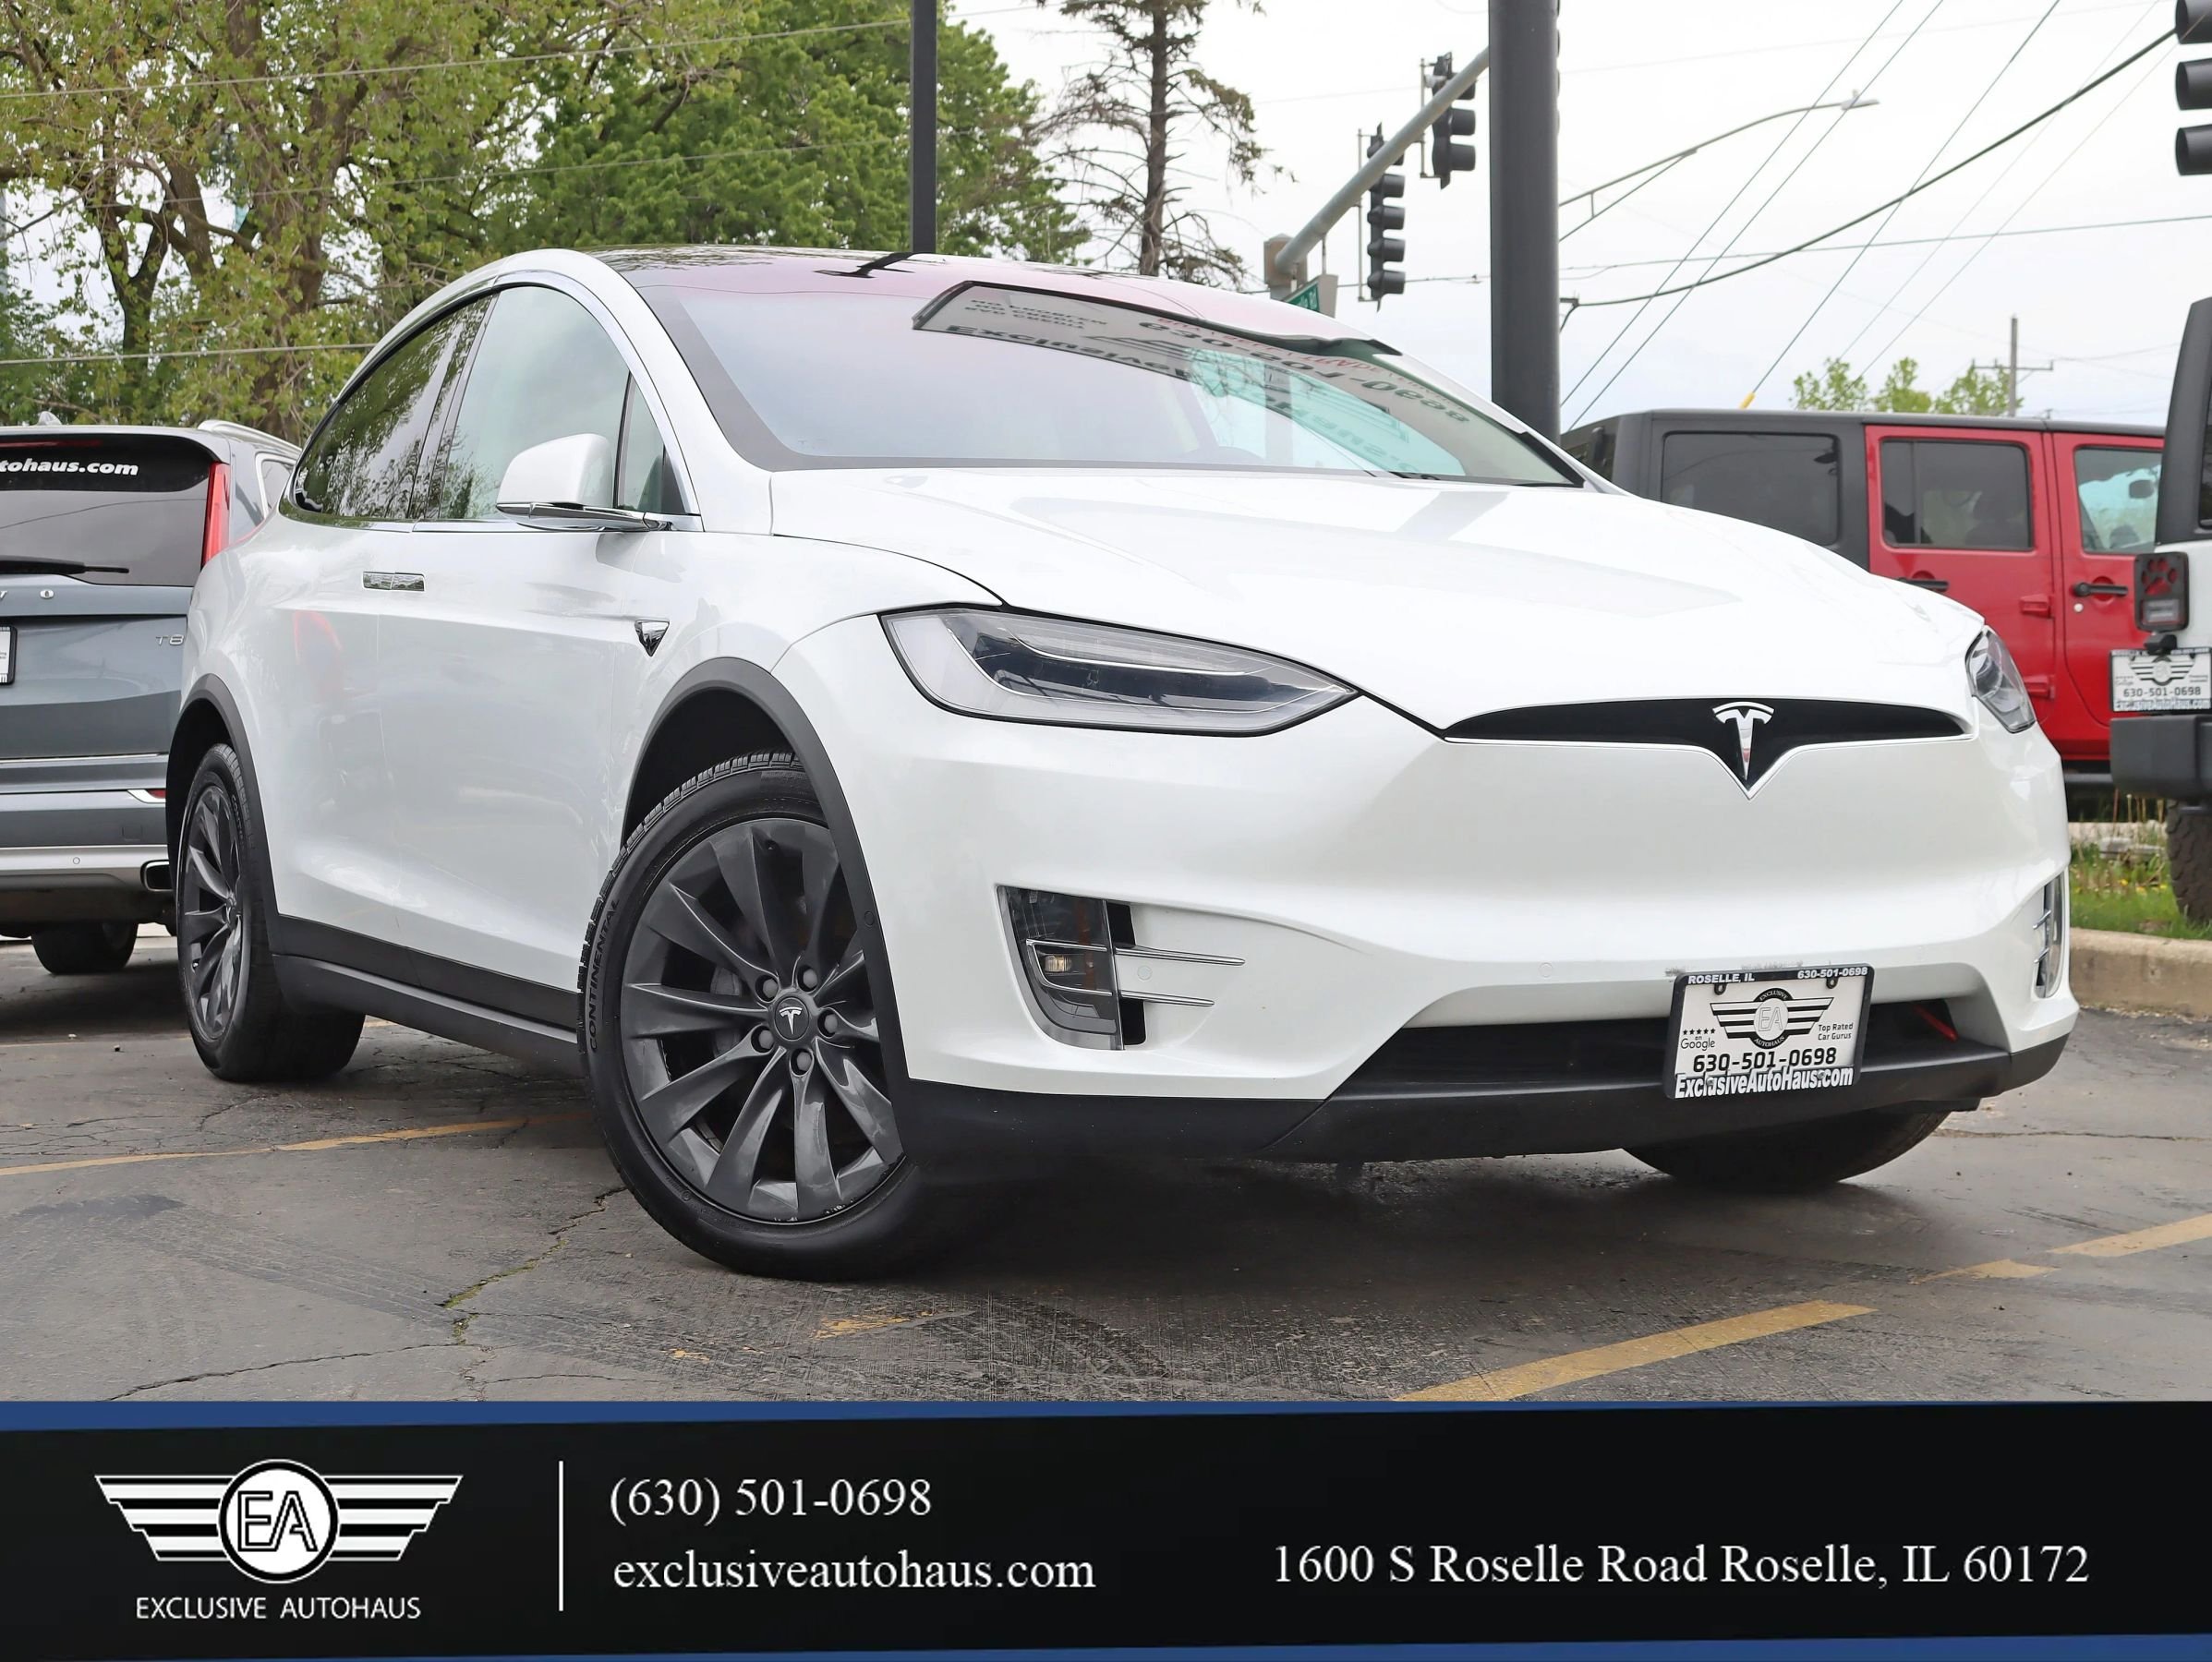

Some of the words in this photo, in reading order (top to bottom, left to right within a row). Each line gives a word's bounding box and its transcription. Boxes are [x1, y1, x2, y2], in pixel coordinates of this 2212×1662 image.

[155, 634, 185, 646] T8
[2123, 686, 2202, 697] 630-501-0698
[588, 898, 620, 1054] CONTINENTAL
[1744, 973, 1755, 982] IL
[1797, 967, 1868, 980] 630-501-0698
[1759, 990, 1789, 1001] EXCLUSIVE
[1818, 1024, 1831, 1032] Top
[1832, 1022, 1854, 1030] Rated
[1681, 1037, 1715, 1051] Google
[1754, 1036, 1785, 1047] AUTOHAUS
[1693, 1047, 1837, 1072] 630-501-0698
[1674, 1065, 1854, 1099] ExclusiveAutoHaus.com
